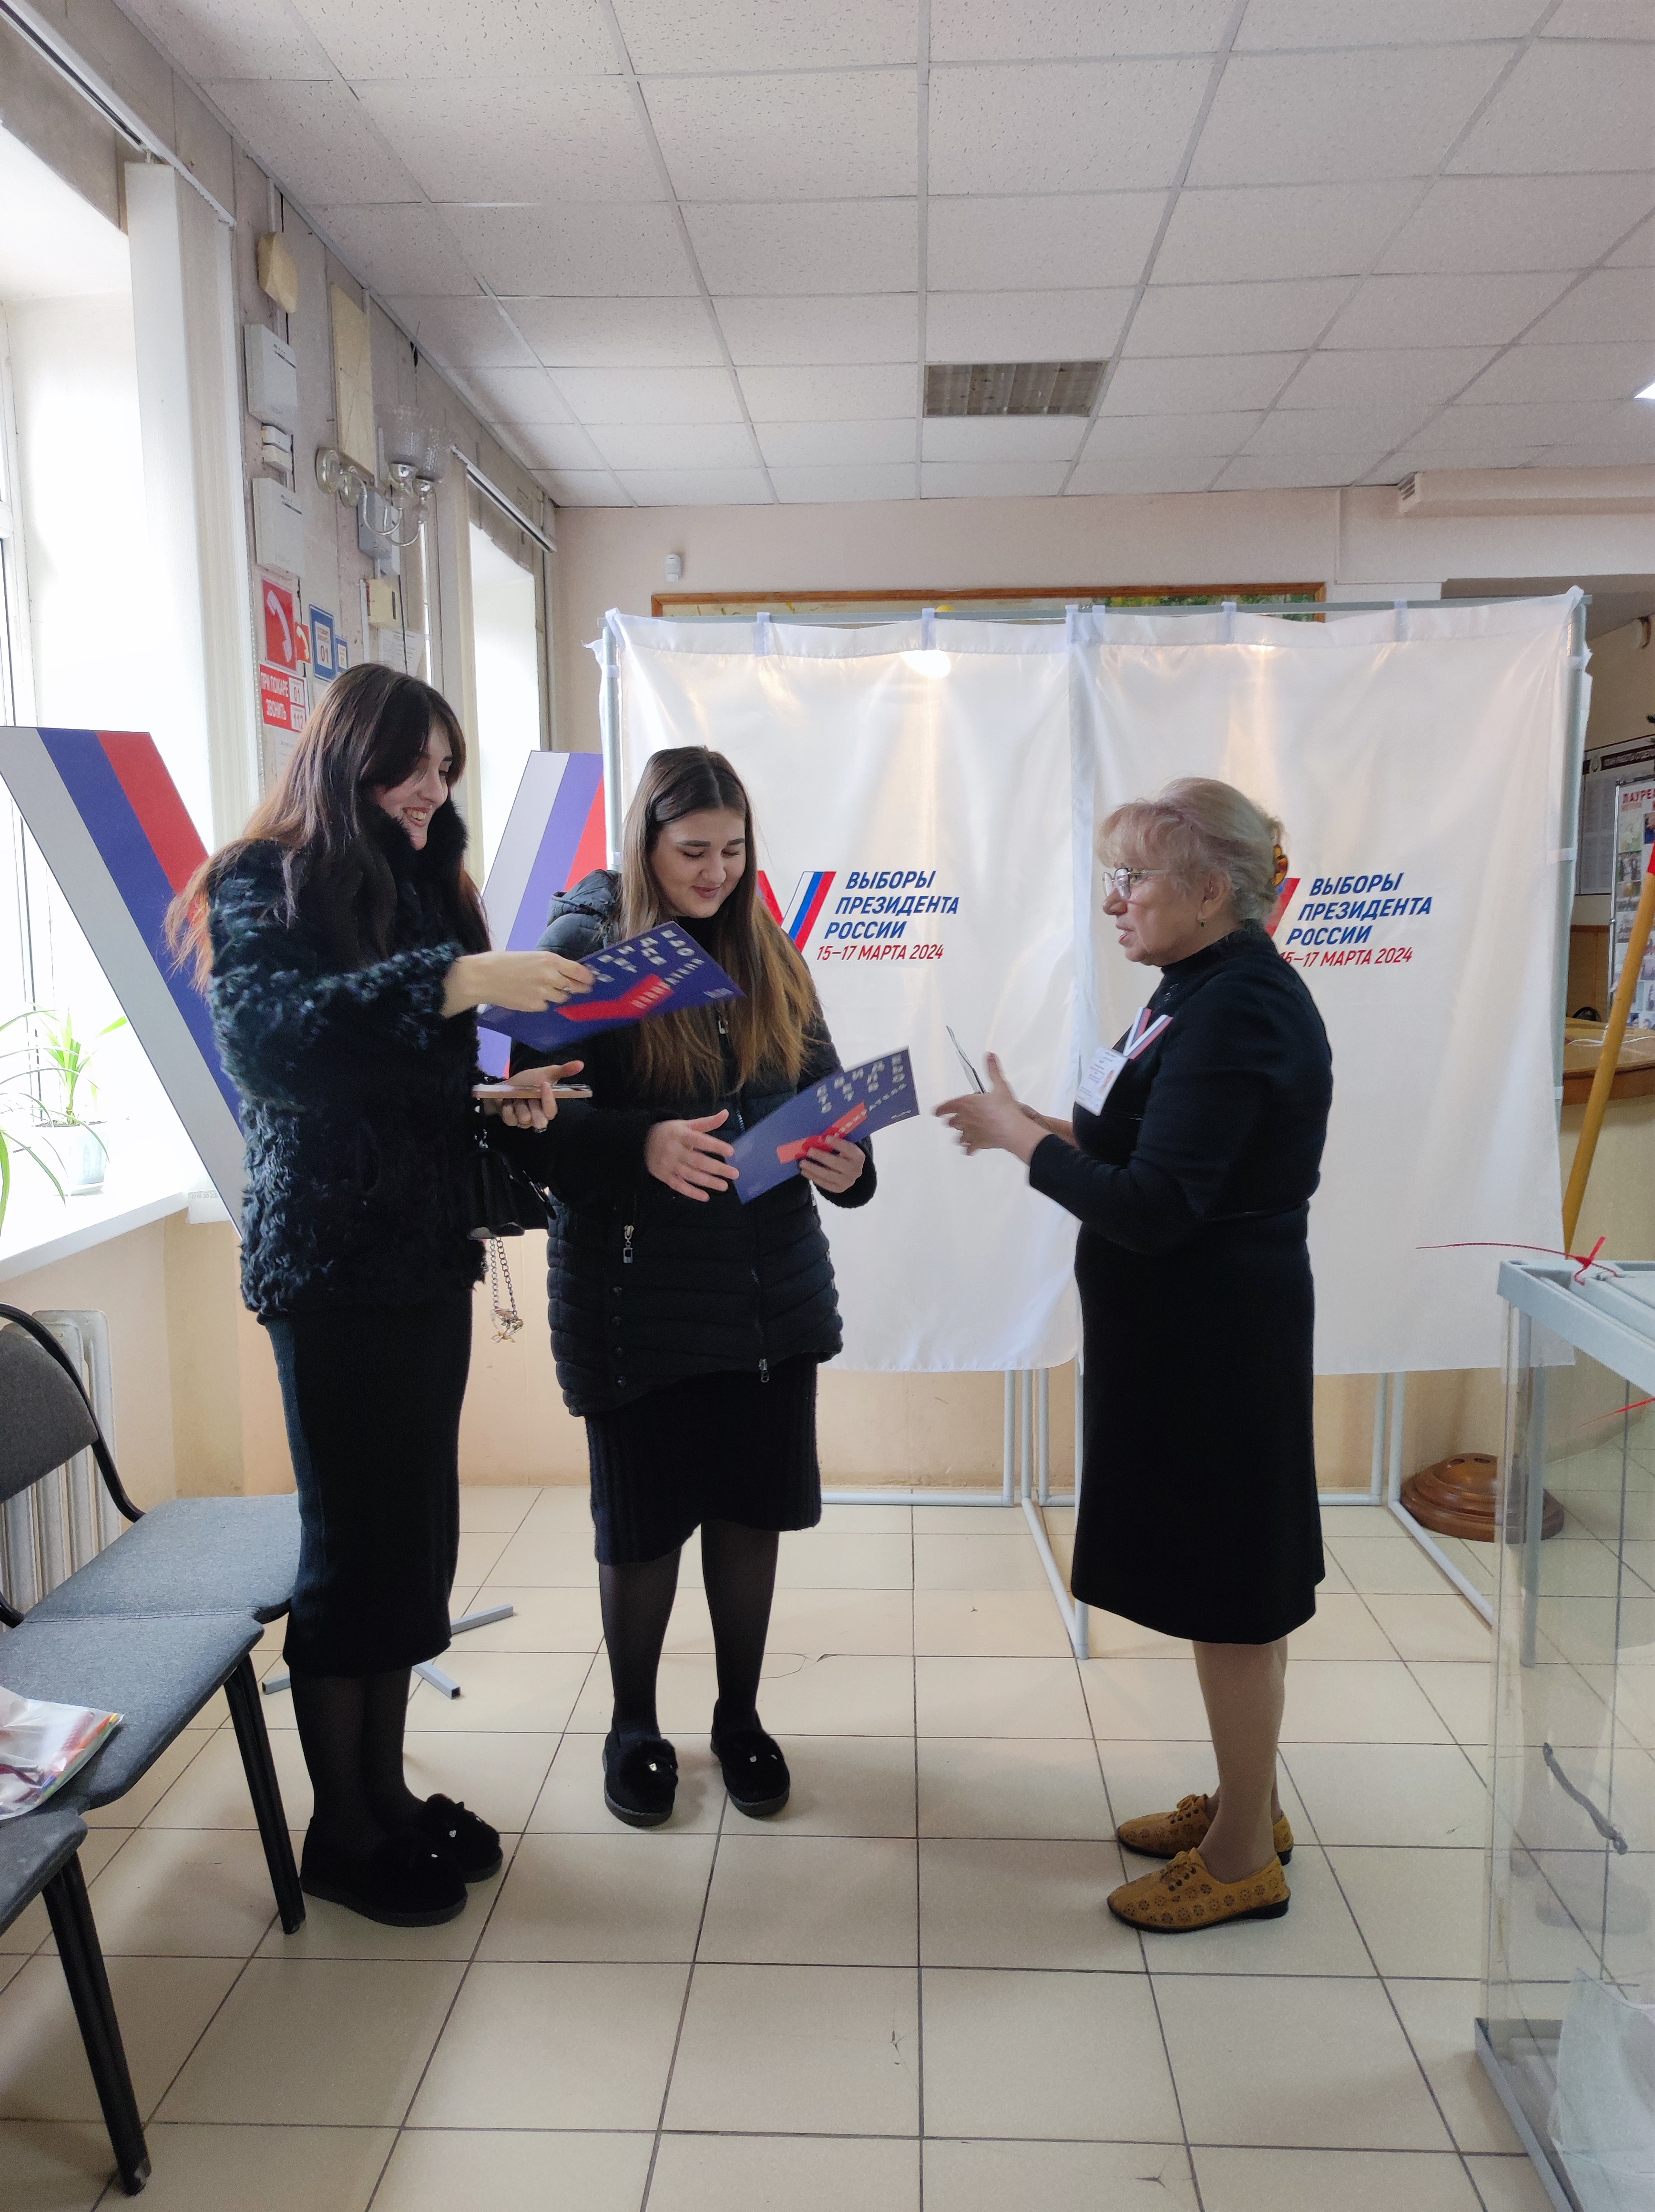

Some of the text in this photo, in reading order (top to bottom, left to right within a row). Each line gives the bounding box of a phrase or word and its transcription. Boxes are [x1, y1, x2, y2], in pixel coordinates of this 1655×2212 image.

[321, 645, 329, 664] 01
[294, 686, 301, 703] 01
[266, 698, 287, 721] ЗВОНИТЬ
[1623, 788, 1655, 803] ЛАУРЕ
[846, 870, 936, 890] ВЫБОРЫ
[1309, 872, 1404, 896] ВЫБОРЫ
[835, 896, 960, 916] ПРЕЗИДЕНТА
[1297, 897, 1432, 921] ПРЕЗИДЕНТА
[824, 921, 908, 940] РОССИИ
[1285, 925, 1373, 945] РОССИИ
[858, 945, 907, 960] МАРТА
[909, 944, 944, 960] 2024
[1320, 950, 1373, 966] МАРТА
[1375, 947, 1413, 964] 2024
